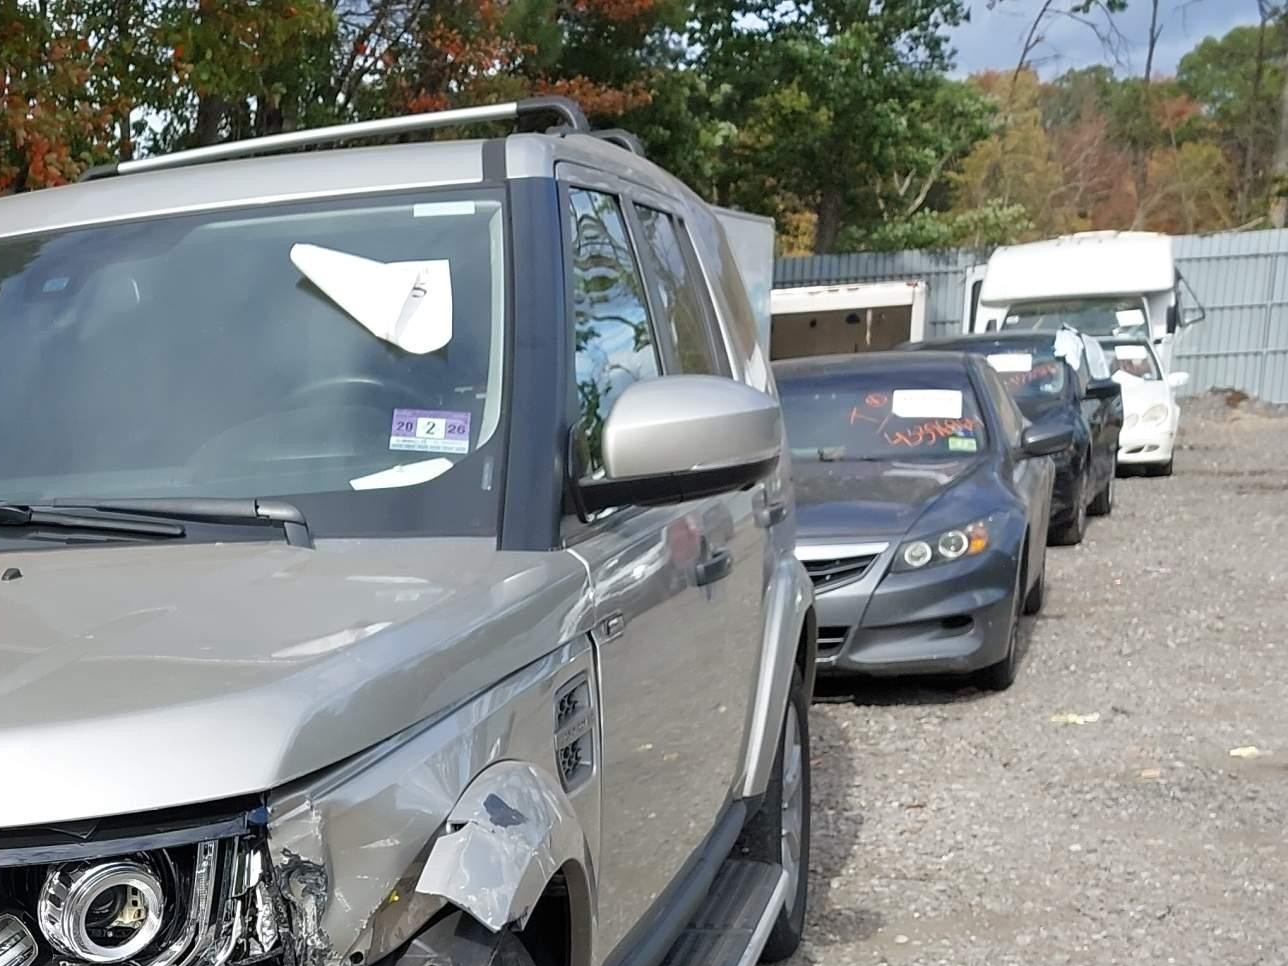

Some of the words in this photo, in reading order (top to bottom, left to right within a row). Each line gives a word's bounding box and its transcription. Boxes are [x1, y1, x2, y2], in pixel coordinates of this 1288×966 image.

[396, 421, 413, 433] 20
[425, 421, 436, 435] 2
[447, 423, 466, 435] 26
